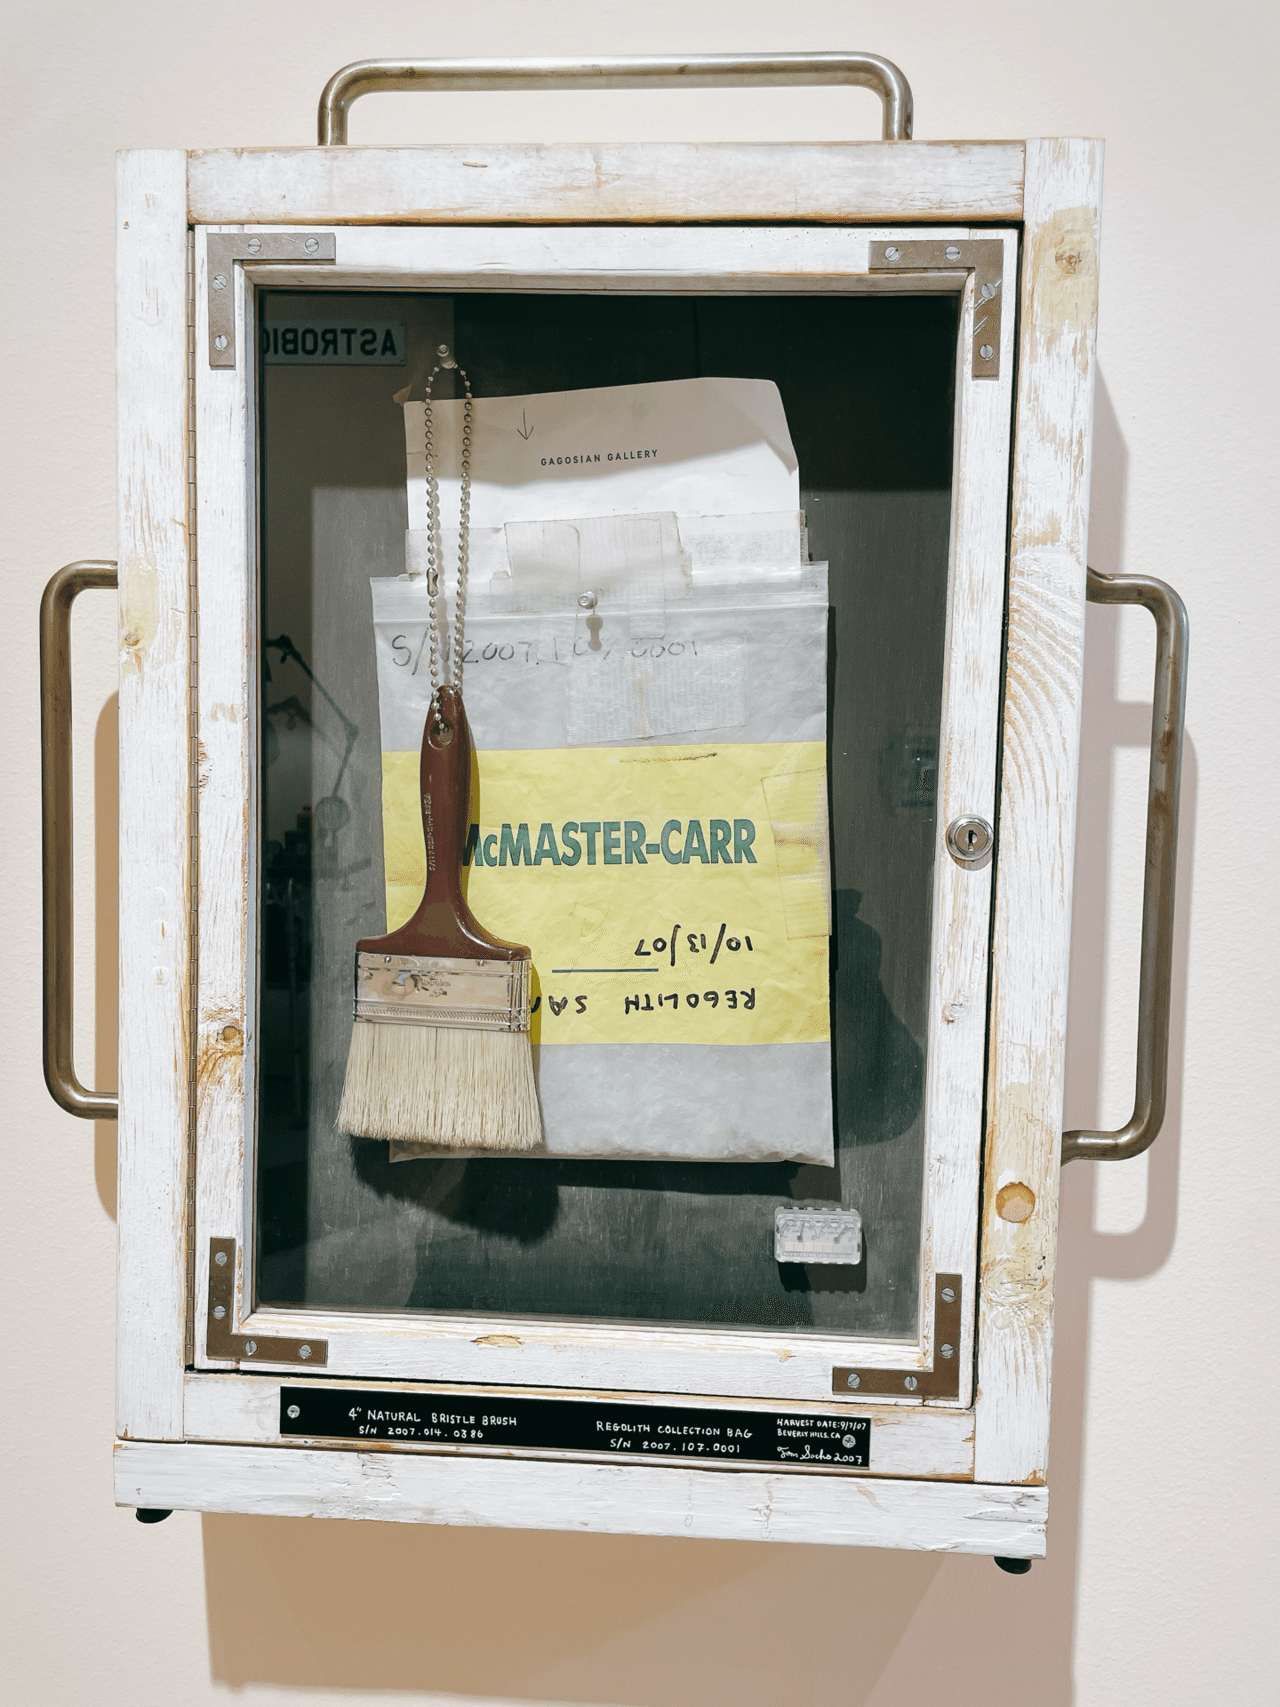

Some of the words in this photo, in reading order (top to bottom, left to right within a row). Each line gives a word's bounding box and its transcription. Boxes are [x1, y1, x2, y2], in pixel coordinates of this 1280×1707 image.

[540, 454, 600, 466] GAGOSIAN
[607, 449, 658, 461] GALLERY
[634, 923, 754, 967] 10/13/07
[624, 987, 756, 1015] REGOLITH
[367, 1409, 421, 1423] NATURAL
[431, 1412, 476, 1425] BRISTLE
[481, 1415, 517, 1426] BRUSH
[776, 1418, 815, 1428] HARVEST
[358, 1424, 378, 1435] S/N
[596, 1420, 651, 1433] REGOLITH
[657, 1424, 720, 1436] COLLECTION
[726, 1427, 753, 1439] BAG
[777, 1428, 809, 1438] BEVERLY
[830, 1431, 841, 1439] CA
[610, 1437, 632, 1449] S/N
[833, 1452, 863, 1465] 2007
